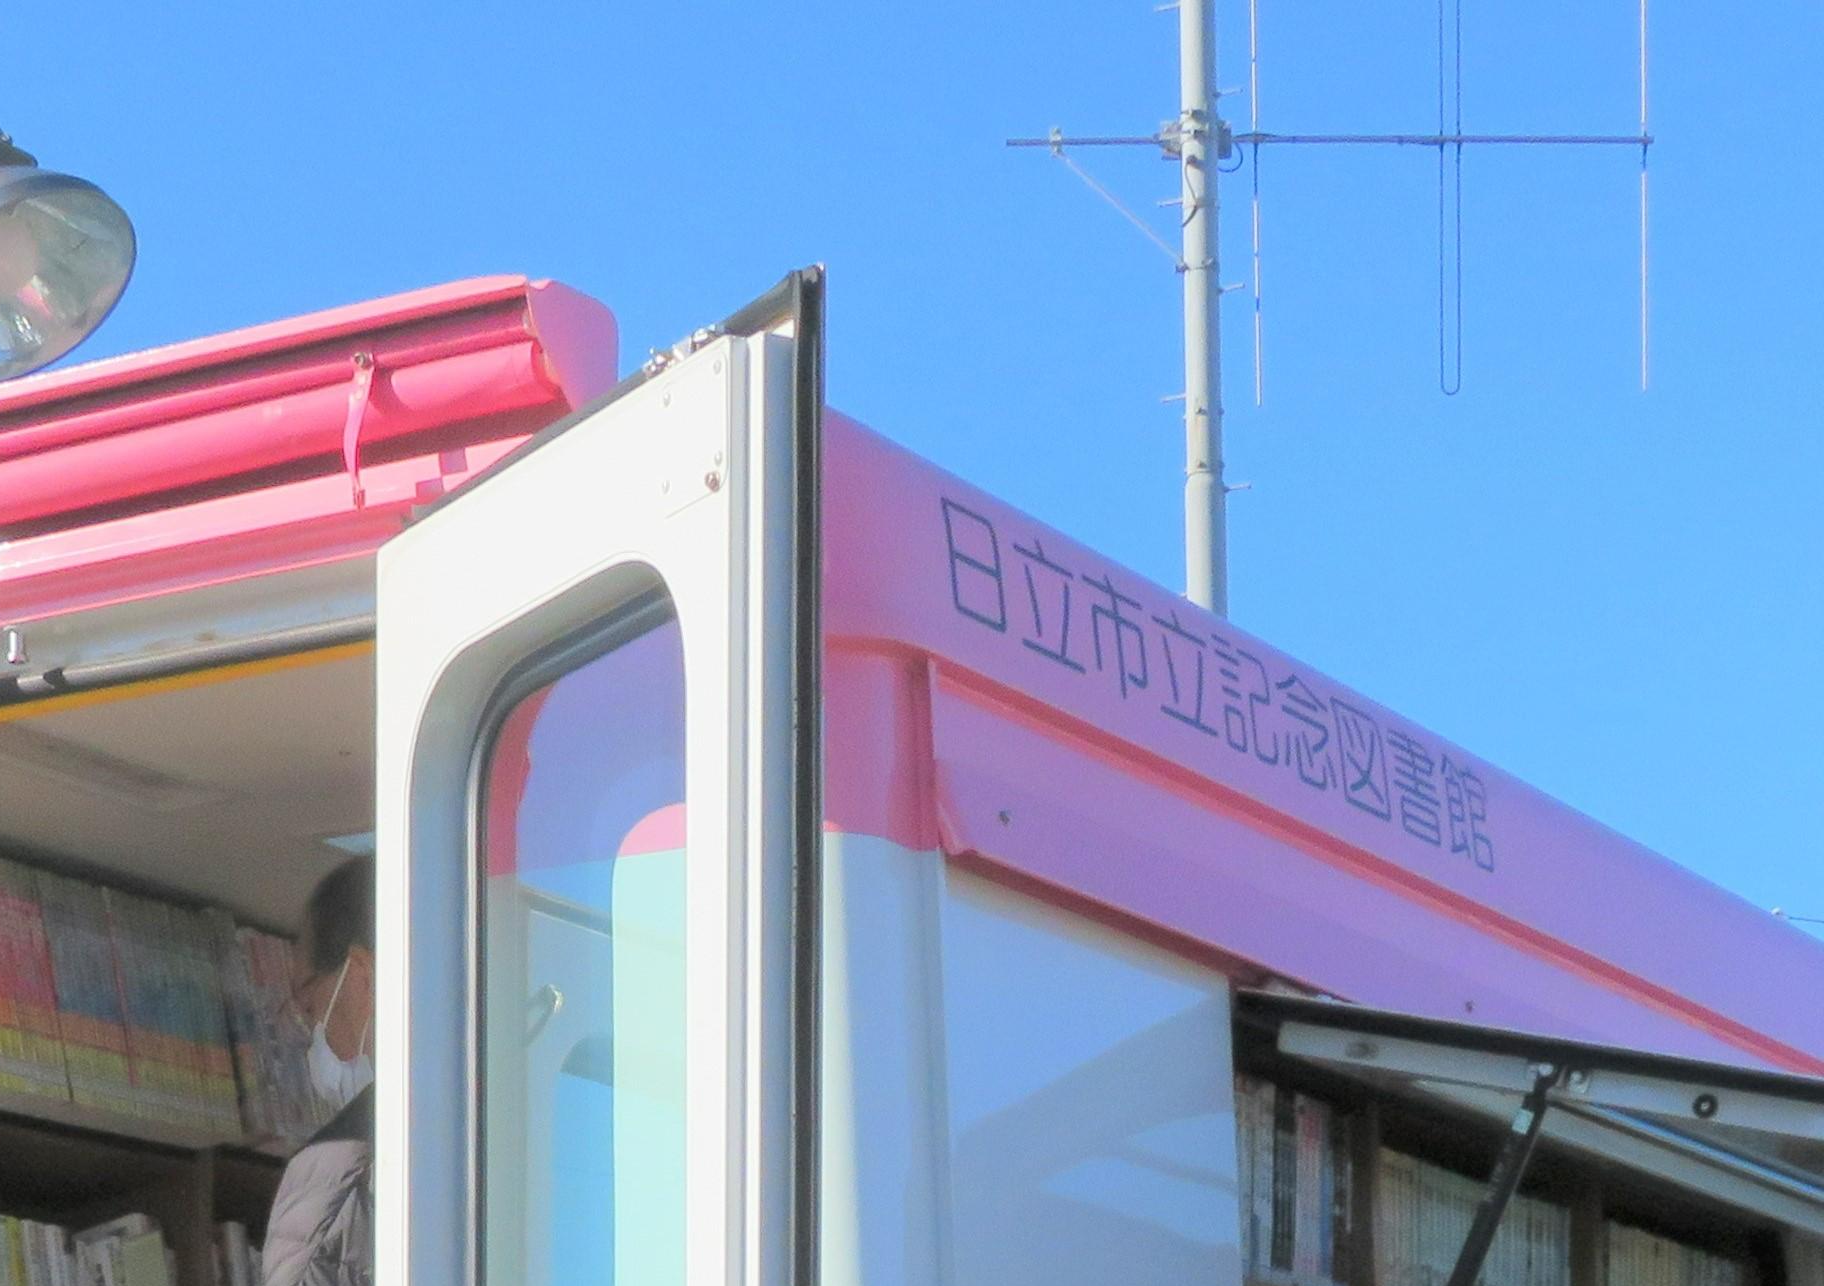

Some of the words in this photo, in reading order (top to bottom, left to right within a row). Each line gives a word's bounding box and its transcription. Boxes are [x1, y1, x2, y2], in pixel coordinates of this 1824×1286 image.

[940, 497, 1495, 873] 日立市立記念図書館
